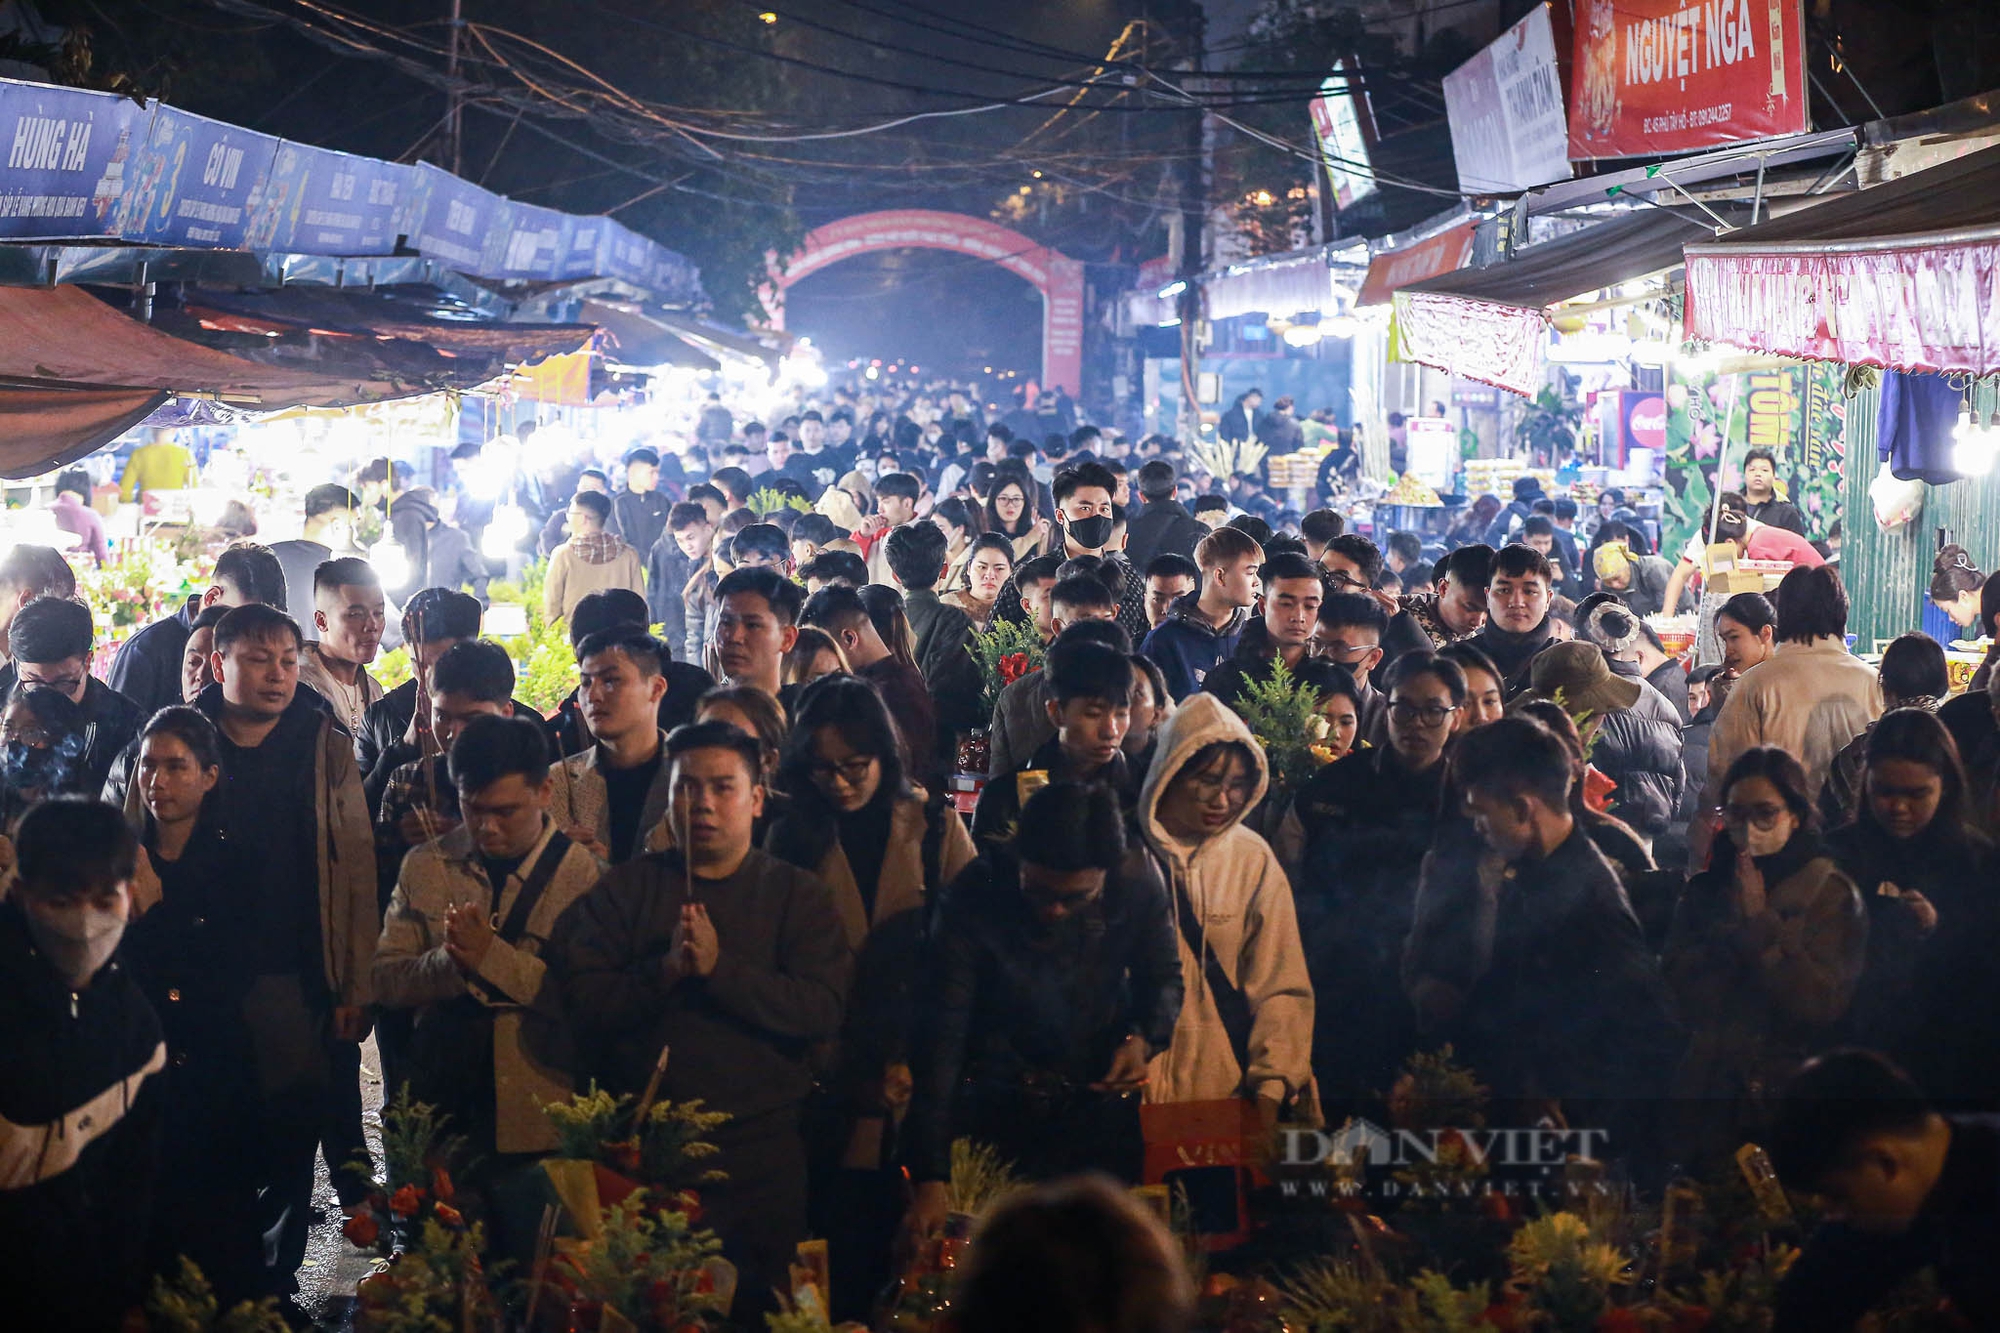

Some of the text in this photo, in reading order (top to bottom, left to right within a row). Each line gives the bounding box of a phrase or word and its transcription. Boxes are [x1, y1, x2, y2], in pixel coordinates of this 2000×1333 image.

[1625, 0, 1755, 92] NGUYỆT NGA
[8, 104, 67, 170] HÙNG
[61, 110, 93, 171] HÀ
[1750, 371, 1800, 447] TÔM
